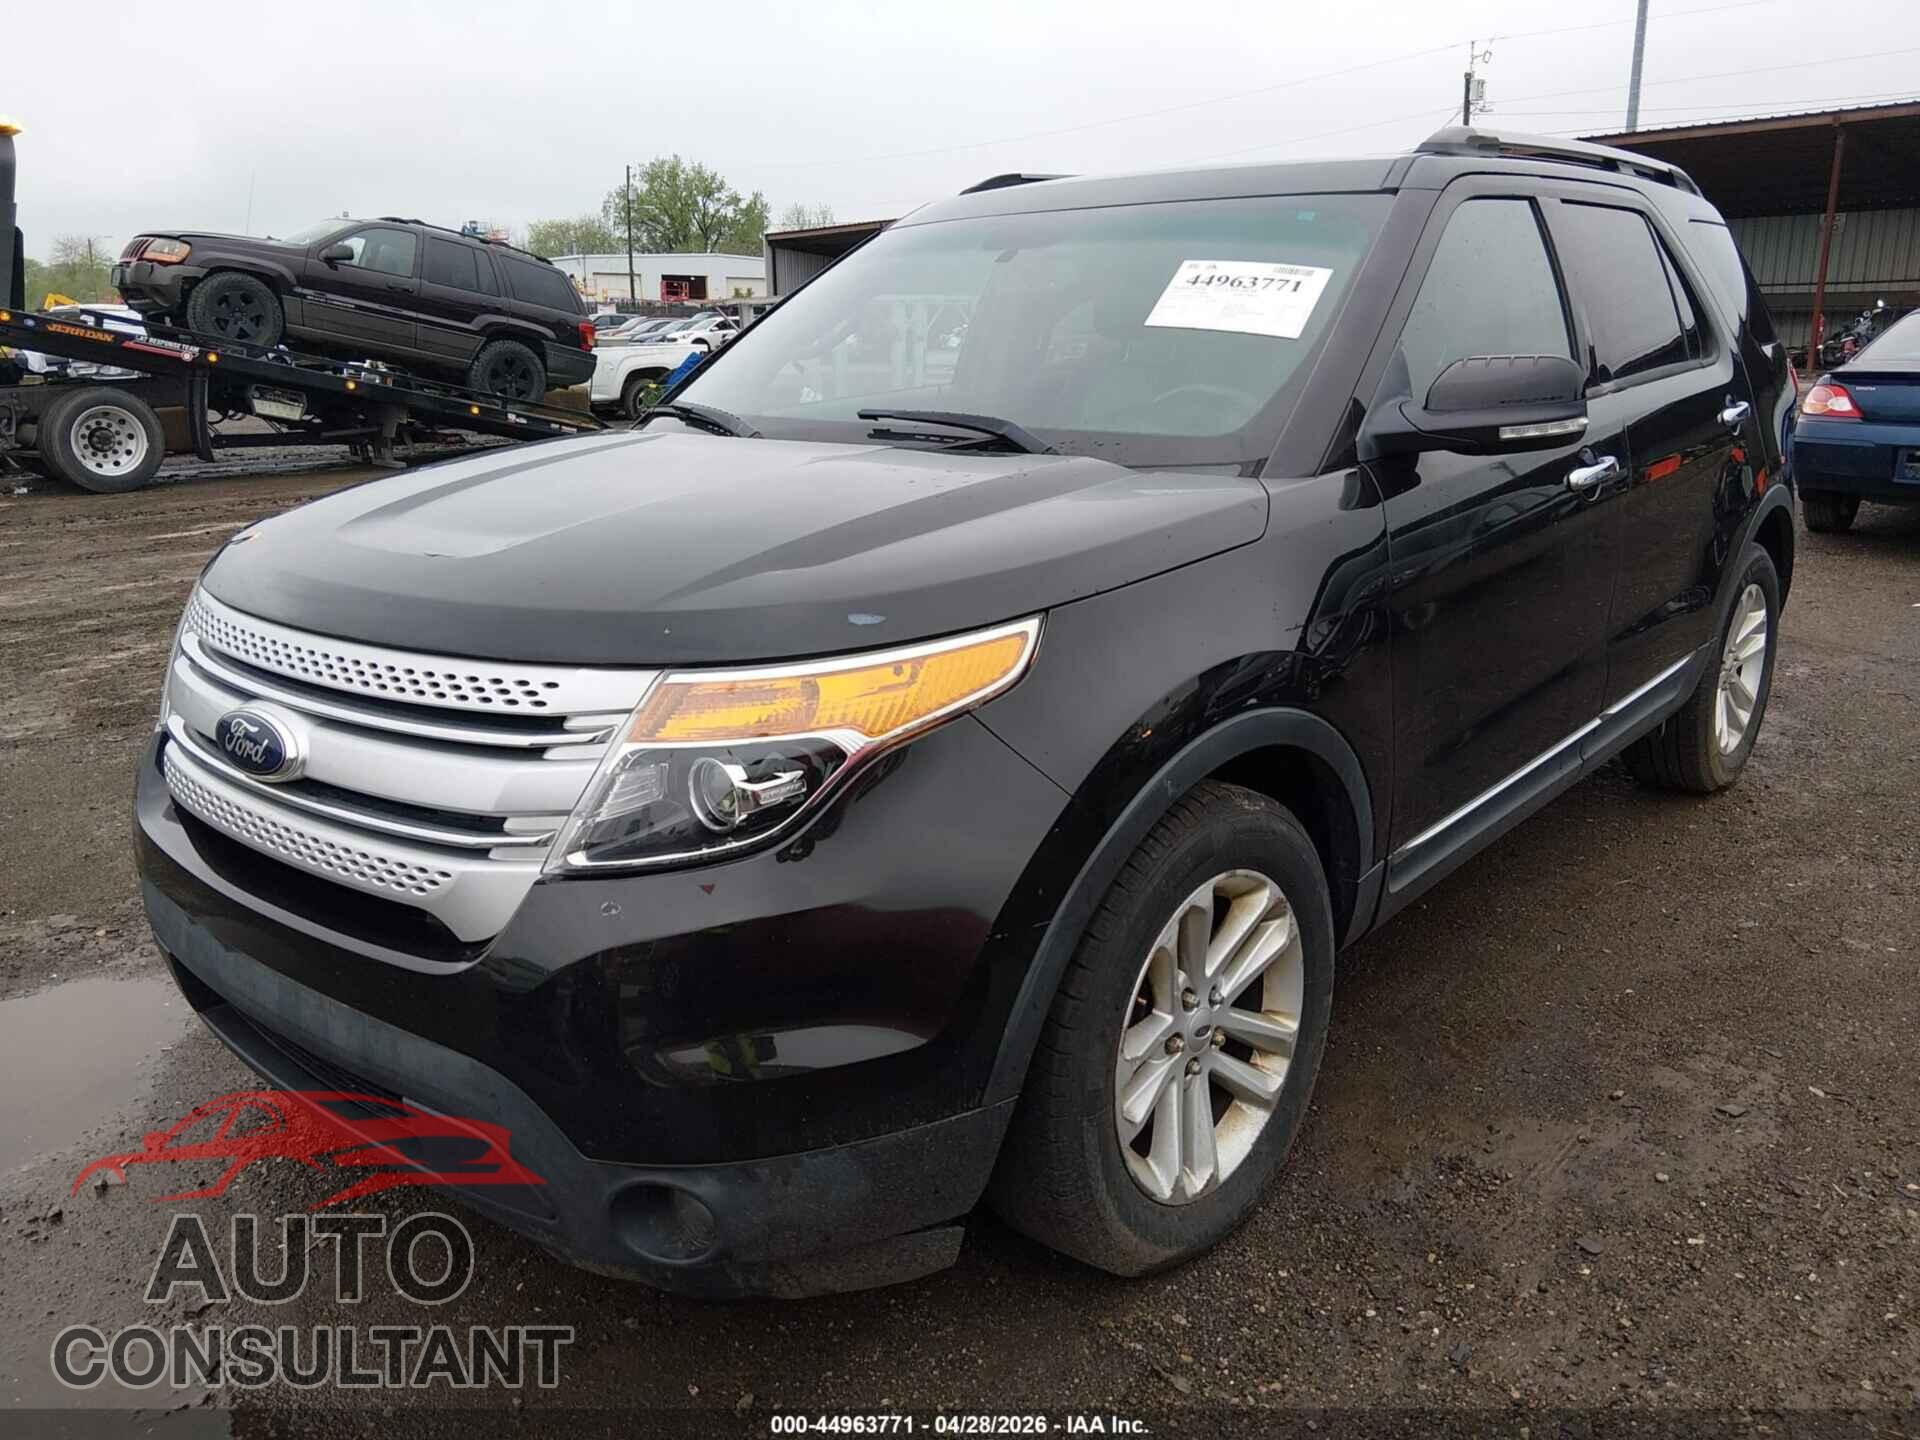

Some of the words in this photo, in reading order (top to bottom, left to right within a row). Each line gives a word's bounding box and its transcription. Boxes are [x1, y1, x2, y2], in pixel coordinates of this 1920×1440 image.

[1186, 274, 1303, 293] 44963771
[182, 344, 200, 353] TEAM
[225, 718, 269, 764] Ford
